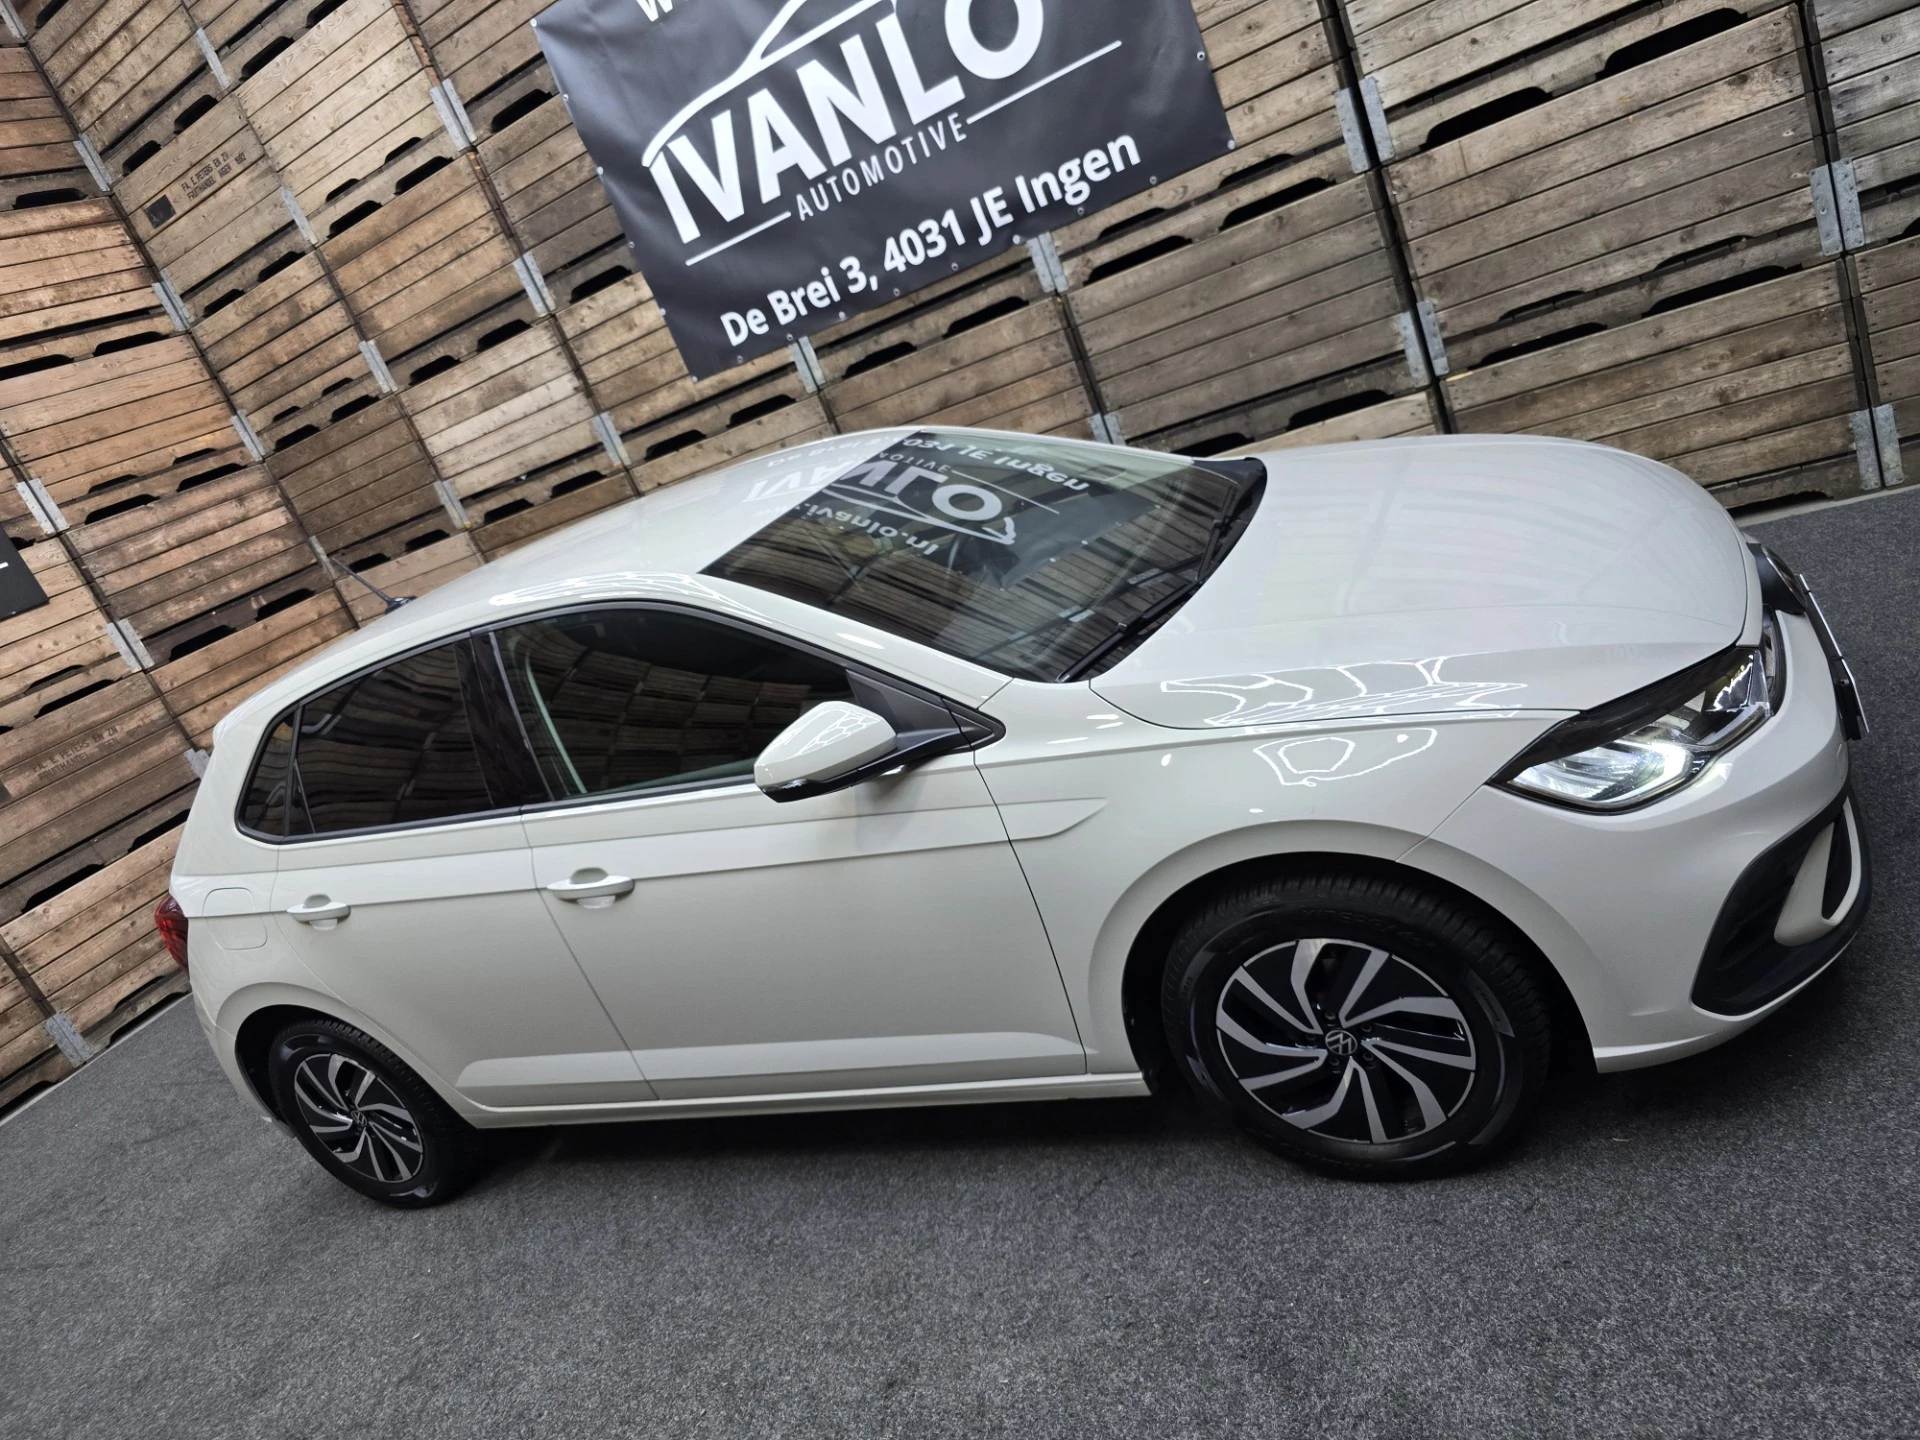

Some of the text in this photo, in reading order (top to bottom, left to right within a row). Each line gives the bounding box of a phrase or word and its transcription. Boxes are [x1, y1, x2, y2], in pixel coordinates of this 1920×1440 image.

[648, 0, 1044, 244] IVANLO
[796, 113, 967, 221] AUTOMOTIVE
[721, 134, 1141, 346] De Brei 3, 4031 JE Ingen
